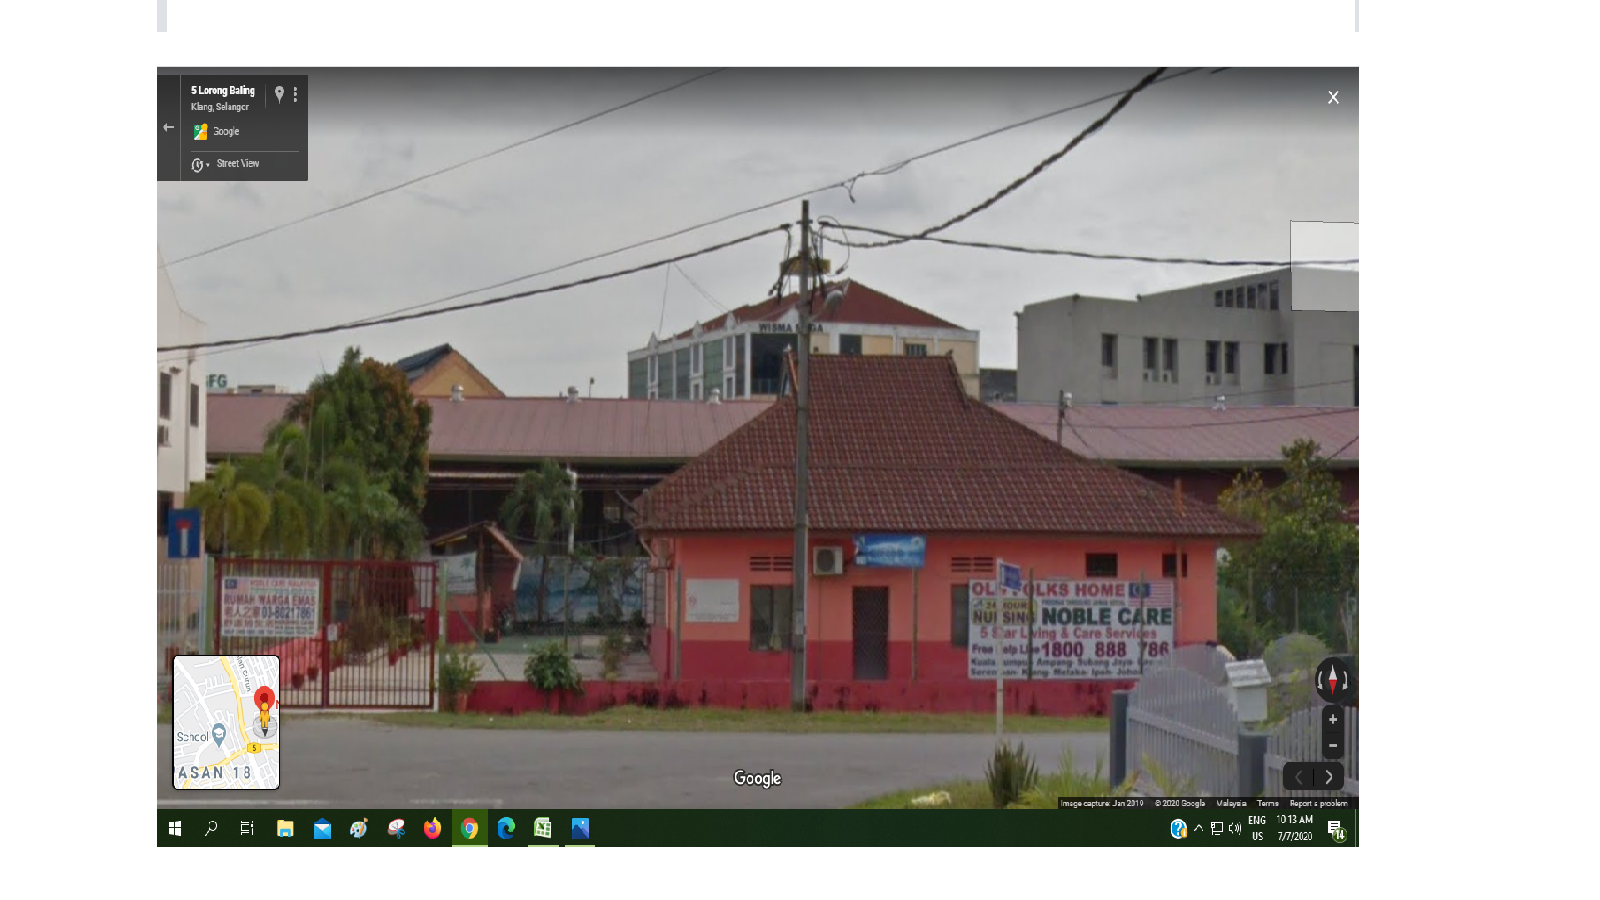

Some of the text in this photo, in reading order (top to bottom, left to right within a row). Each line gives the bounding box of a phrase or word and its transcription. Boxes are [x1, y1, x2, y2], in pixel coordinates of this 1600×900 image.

[758, 323, 793, 334] WISMA
[1011, 582, 1070, 598] OLKS
[1075, 583, 1125, 597] HOME
[259, 595, 290, 606] WARGA
[1041, 607, 1173, 626] NOBLE CARE
[980, 626, 1157, 641] 5 Sar Lving & Care Services
[995, 644, 1018, 656] elp
[1041, 641, 1085, 657] 1800
[1095, 641, 1127, 657] 888
